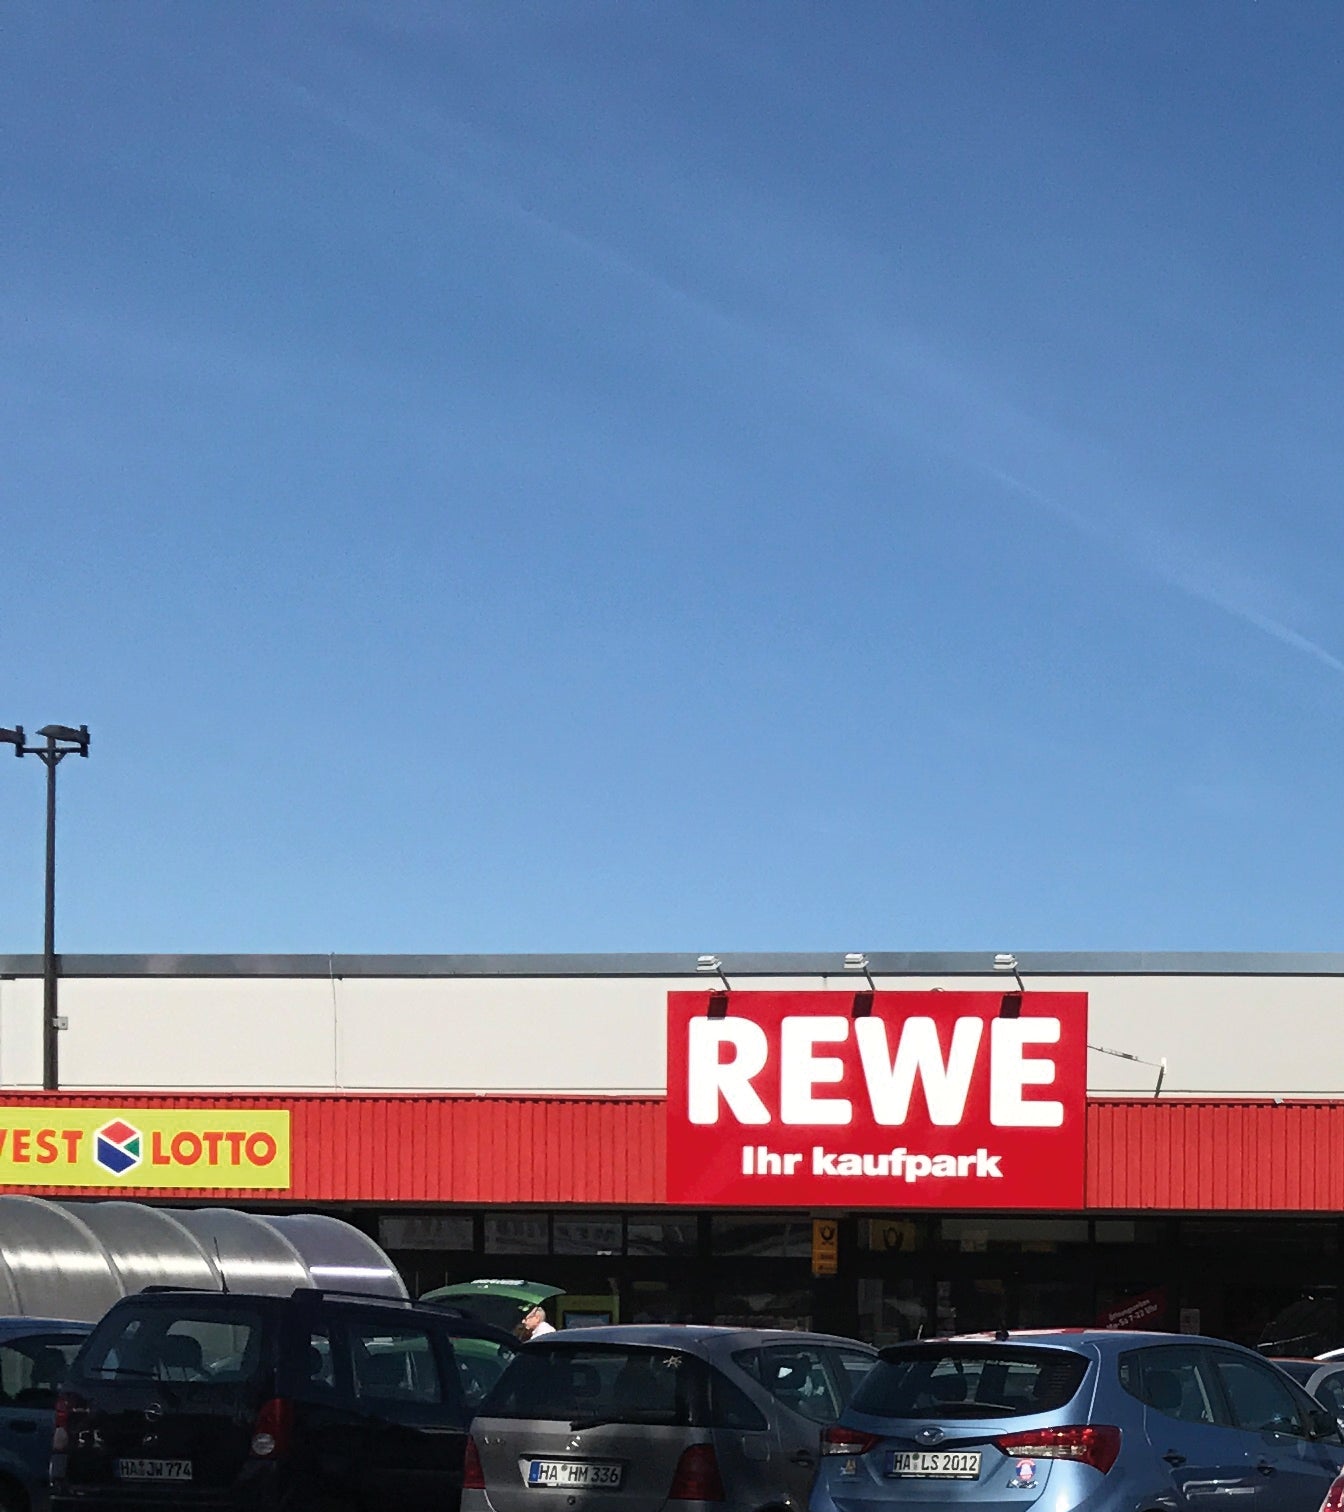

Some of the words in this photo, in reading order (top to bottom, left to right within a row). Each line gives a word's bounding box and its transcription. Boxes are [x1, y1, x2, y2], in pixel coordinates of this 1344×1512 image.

[688, 1016, 1064, 1127] REWE
[152, 1131, 277, 1167] LOTTO
[742, 1146, 803, 1175] Ihr
[812, 1147, 1003, 1182] kaufpark
[539, 1465, 558, 1480] HA
[568, 1466, 588, 1482] HM
[590, 1467, 619, 1484] 336
[894, 1454, 911, 1471] HA
[921, 1454, 940, 1471] LS
[942, 1454, 978, 1472] 2012
